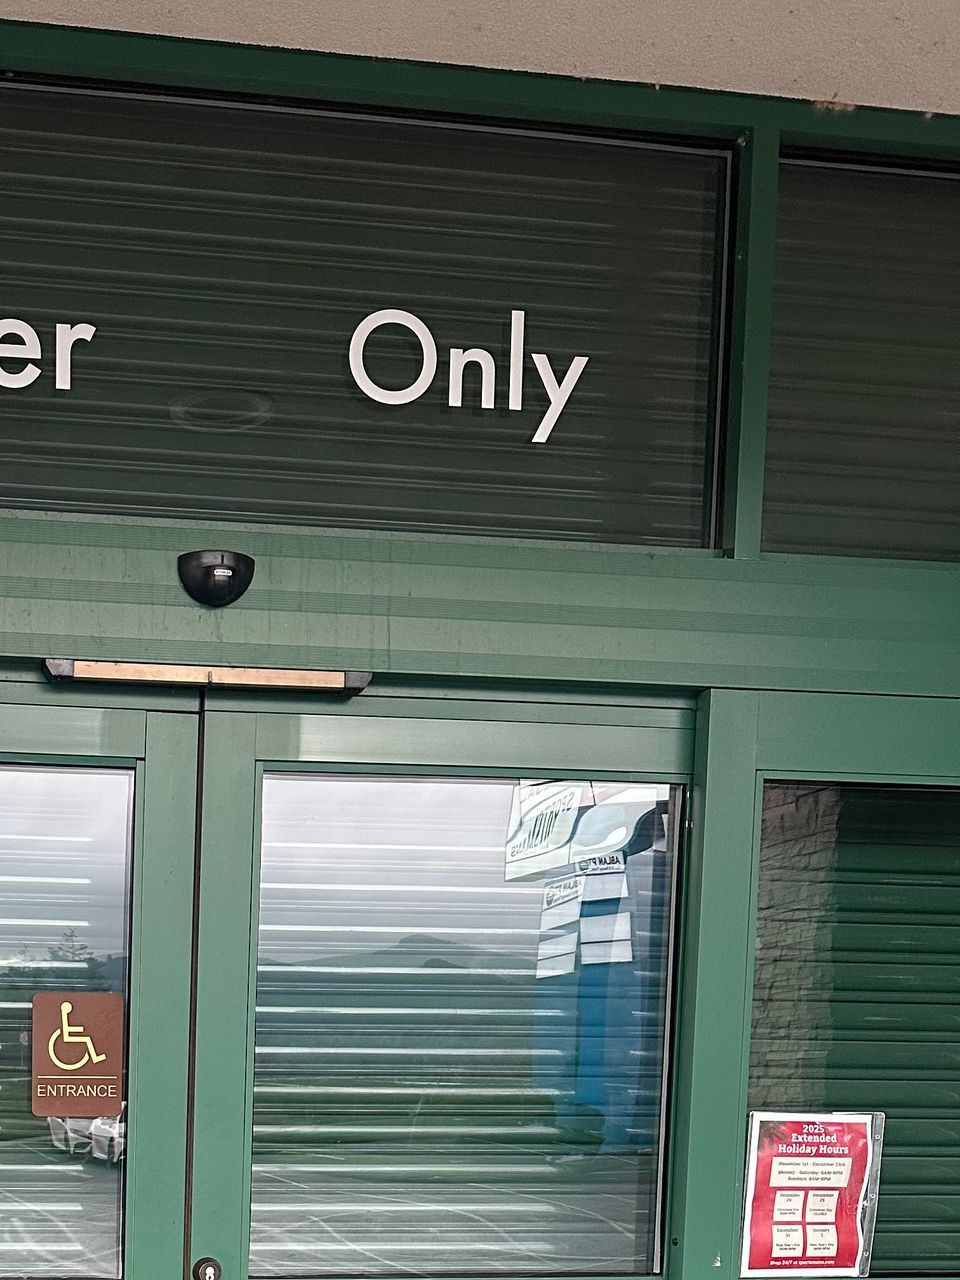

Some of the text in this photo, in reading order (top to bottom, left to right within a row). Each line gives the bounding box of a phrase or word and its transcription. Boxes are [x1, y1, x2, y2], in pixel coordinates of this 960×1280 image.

[348, 309, 589, 443] Only
[37, 1085, 117, 1096] ENTRANCE
[803, 1125, 825, 1133] 2025
[791, 1134, 837, 1142] Extended
[778, 1145, 848, 1155] Holiday Hours
